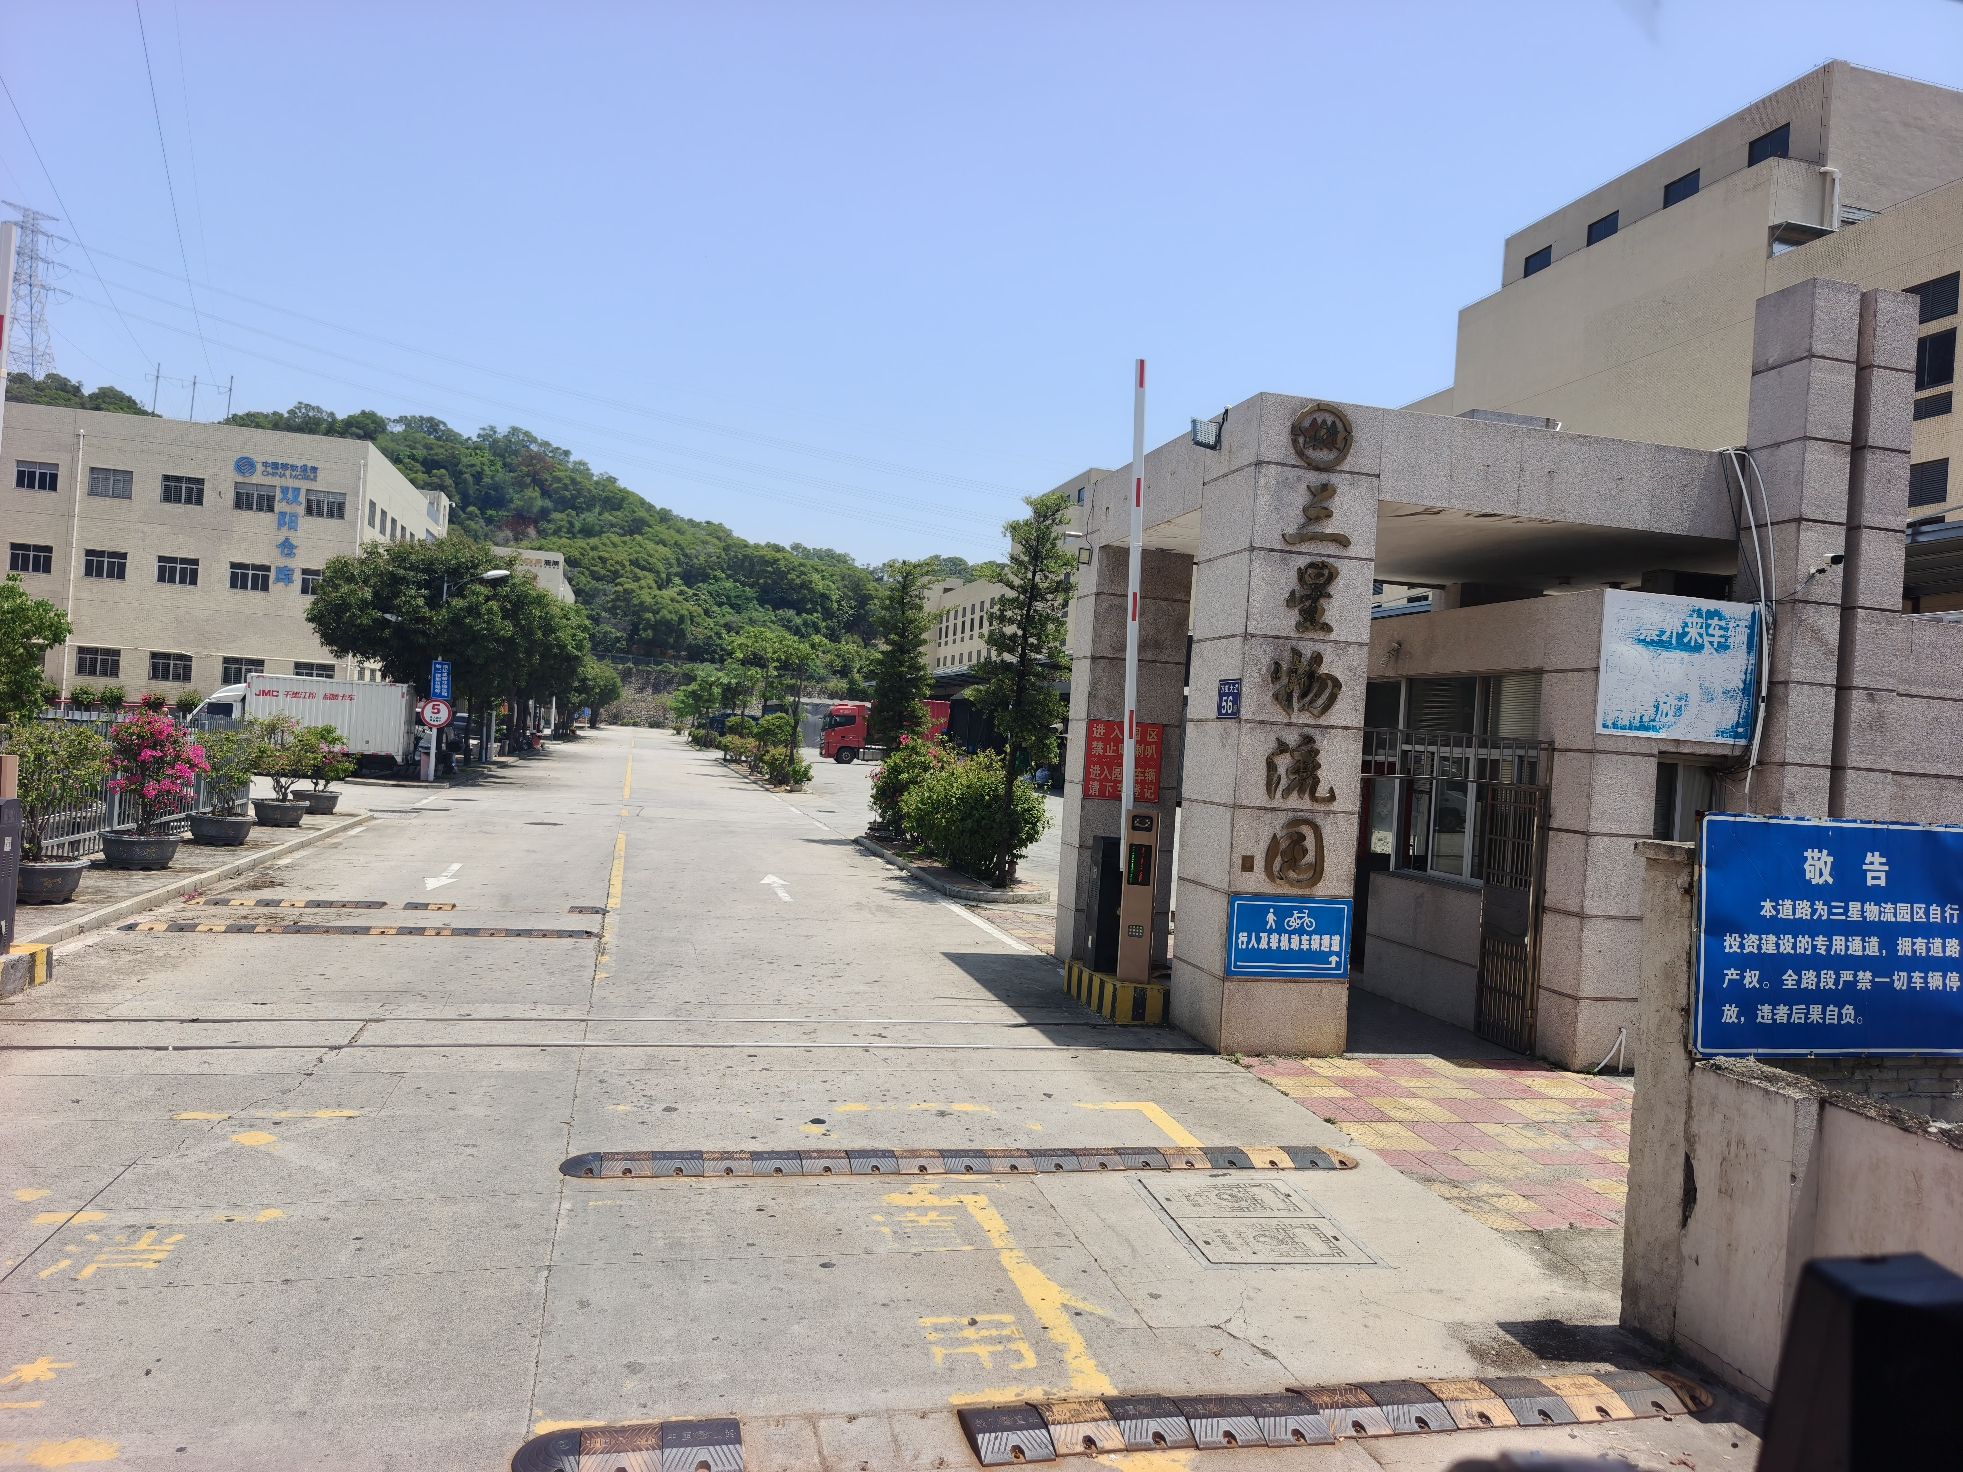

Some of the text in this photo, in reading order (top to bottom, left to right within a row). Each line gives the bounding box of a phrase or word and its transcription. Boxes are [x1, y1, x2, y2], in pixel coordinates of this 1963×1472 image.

[273, 486, 303, 587] 双阳仓库
[254, 689, 280, 698] JMC
[431, 703, 442, 715] 5
[1089, 764, 1156, 783] 进入园车辆
[1803, 848, 1890, 887] 敬告
[1760, 898, 1960, 924] 本道路为三星物流园区自行
[1238, 931, 1341, 952] 行人及非机动车辆通道
[1722, 968, 1962, 992] 产权。全路段严禁一切车辆停
[1721, 1003, 1863, 1025] 放，违者后果自负。
